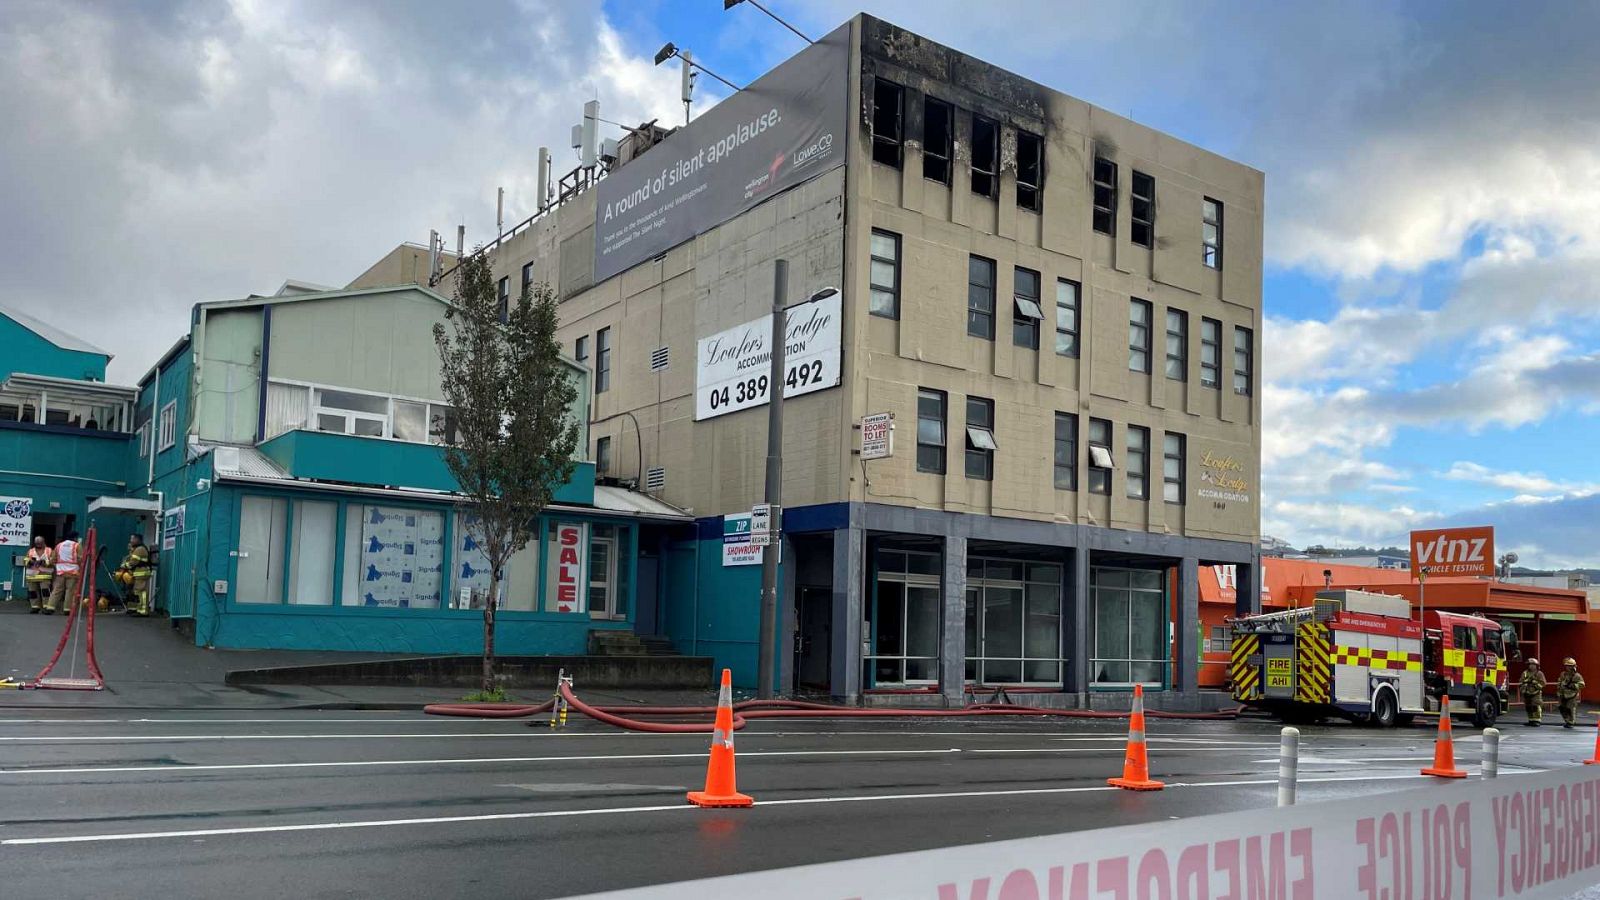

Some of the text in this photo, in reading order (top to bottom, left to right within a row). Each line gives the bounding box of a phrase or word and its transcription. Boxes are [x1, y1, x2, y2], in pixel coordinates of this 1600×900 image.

[604, 108, 782, 224] A round of silent applause.
[737, 341, 806, 371] ACCOMMTION
[710, 359, 823, 410] 04 389 492
[864, 423, 887, 432] ROOMS
[864, 431, 886, 440] TO LET
[1198, 488, 1249, 502] ACCOMMODATION
[735, 520, 748, 532] ZIP
[752, 521, 767, 530] LANE
[1416, 534, 1487, 563] vtnz
[558, 528, 578, 602] SALE
[1453, 563, 1485, 573] TESTING
[1269, 659, 1290, 669] FIRE
[1272, 677, 1288, 686] AHI
